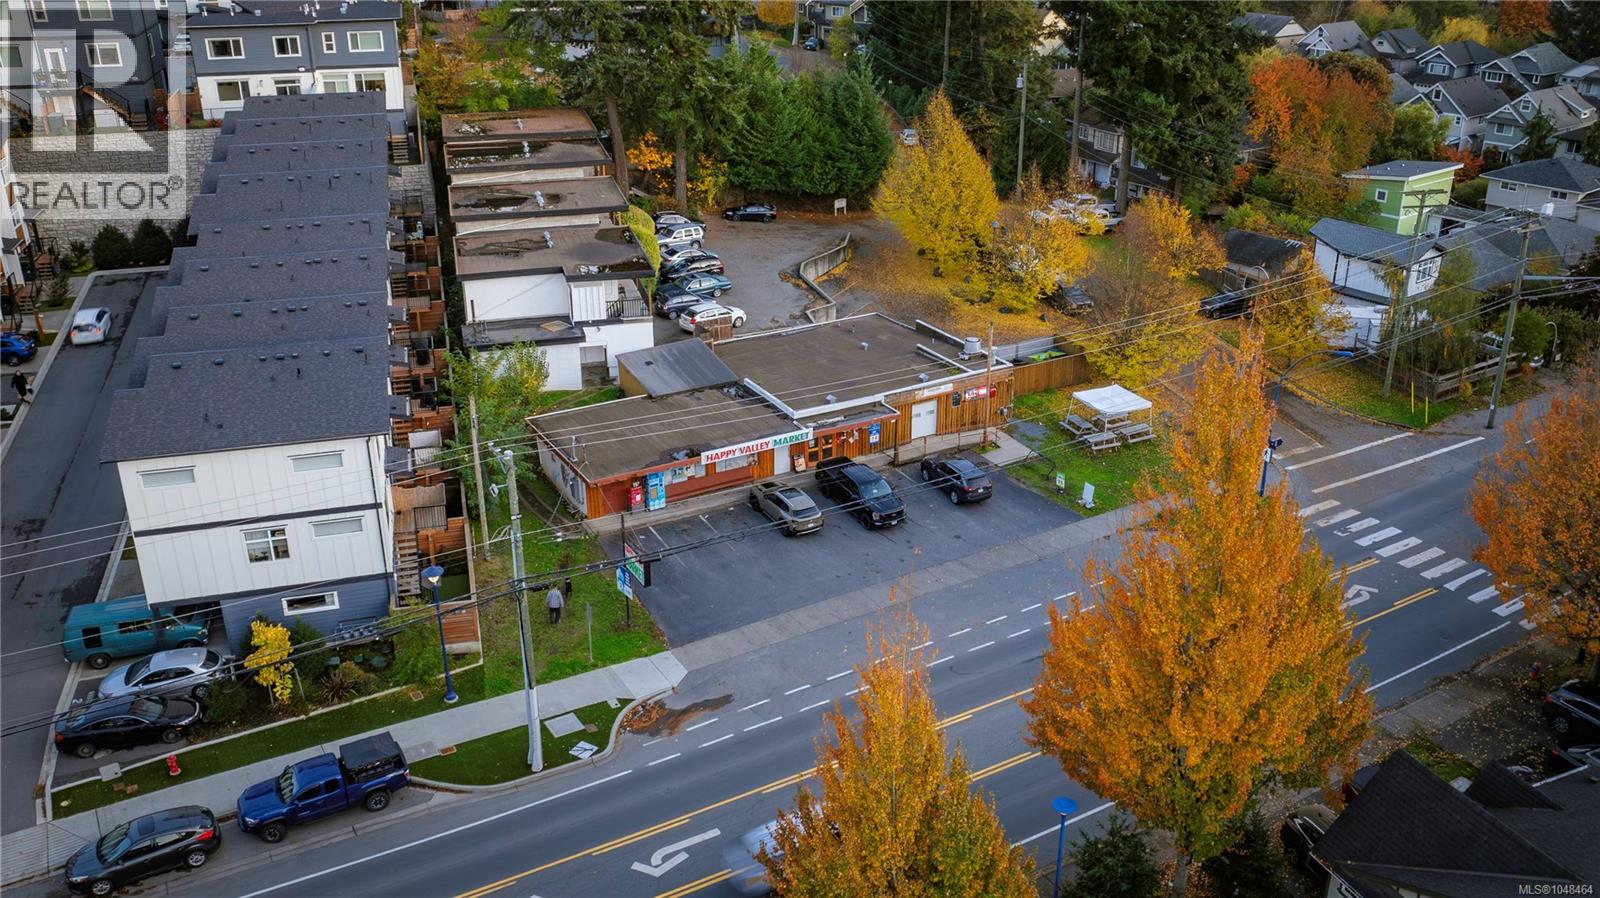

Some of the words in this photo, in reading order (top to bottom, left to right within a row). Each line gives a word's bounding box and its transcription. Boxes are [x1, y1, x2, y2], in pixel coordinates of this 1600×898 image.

[706, 449, 737, 462] HAPPY
[739, 441, 770, 454] VALLEY
[773, 431, 810, 447] MARKET
